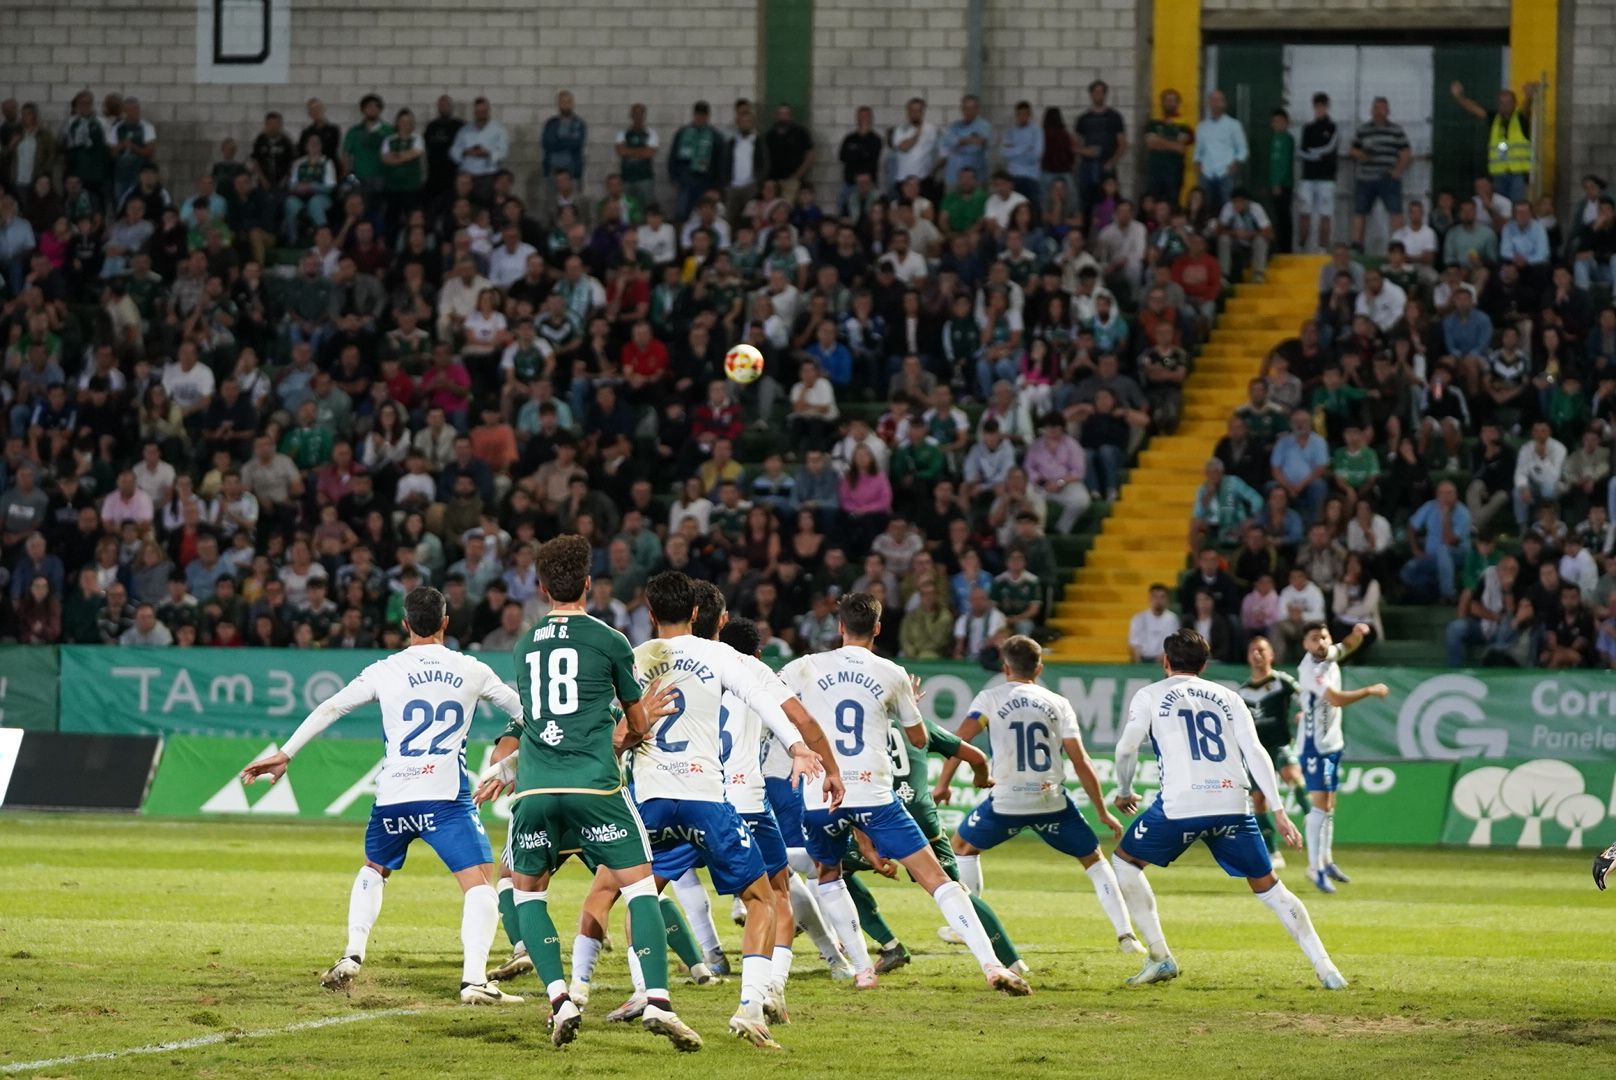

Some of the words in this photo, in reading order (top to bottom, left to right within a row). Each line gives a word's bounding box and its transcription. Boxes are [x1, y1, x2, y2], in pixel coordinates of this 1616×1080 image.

[533, 623, 555, 642] RAÚL
[558, 625, 569, 639] S.
[408, 670, 463, 688] ÁLVARO
[525, 648, 579, 720] 18
[638, 662, 669, 689] AVID
[817, 673, 836, 691] DE
[838, 671, 885, 701] MIGUEL
[997, 697, 1028, 720] AITOR
[1159, 688, 1185, 717] ENRIC
[399, 699, 464, 757] 22
[656, 688, 689, 752] 2
[835, 699, 865, 756] 9
[1009, 721, 1052, 772] 16
[1178, 709, 1226, 762] 18
[383, 813, 436, 834] EAVE
[591, 823, 617, 835] MÁS
[594, 829, 628, 842] MEDIO
